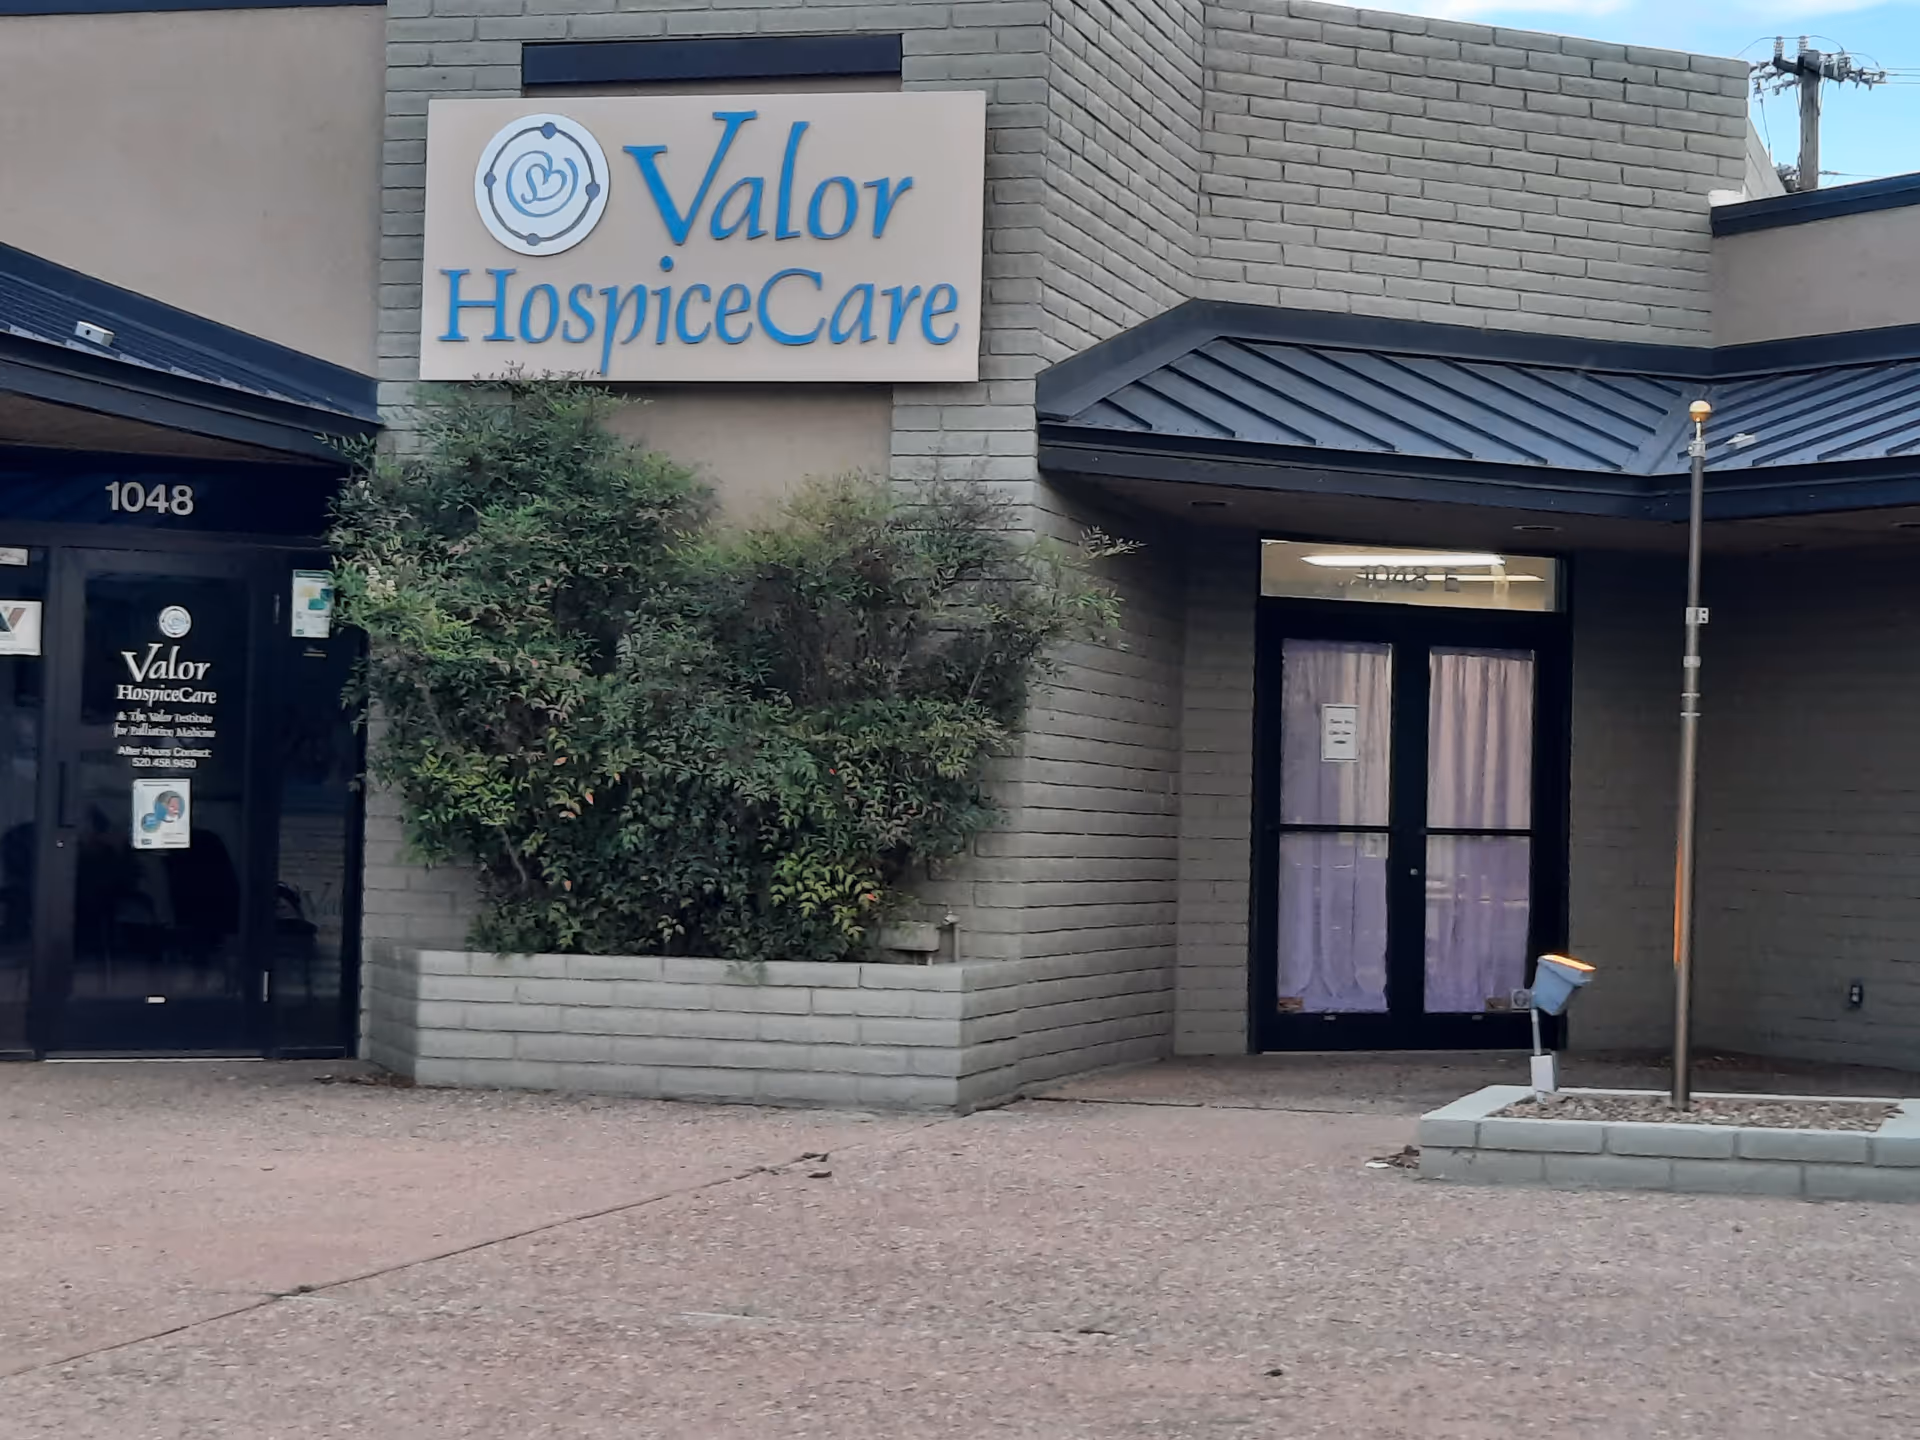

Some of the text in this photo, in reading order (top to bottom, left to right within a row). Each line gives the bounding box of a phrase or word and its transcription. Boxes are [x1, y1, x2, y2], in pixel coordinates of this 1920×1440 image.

[622, 110, 914, 246] Valor
[437, 254, 960, 376] HospiceCare
[105, 481, 194, 516] 1048
[121, 643, 211, 682] Valor
[117, 684, 217, 707] HospiceCare
[142, 746, 171, 756] Hours
